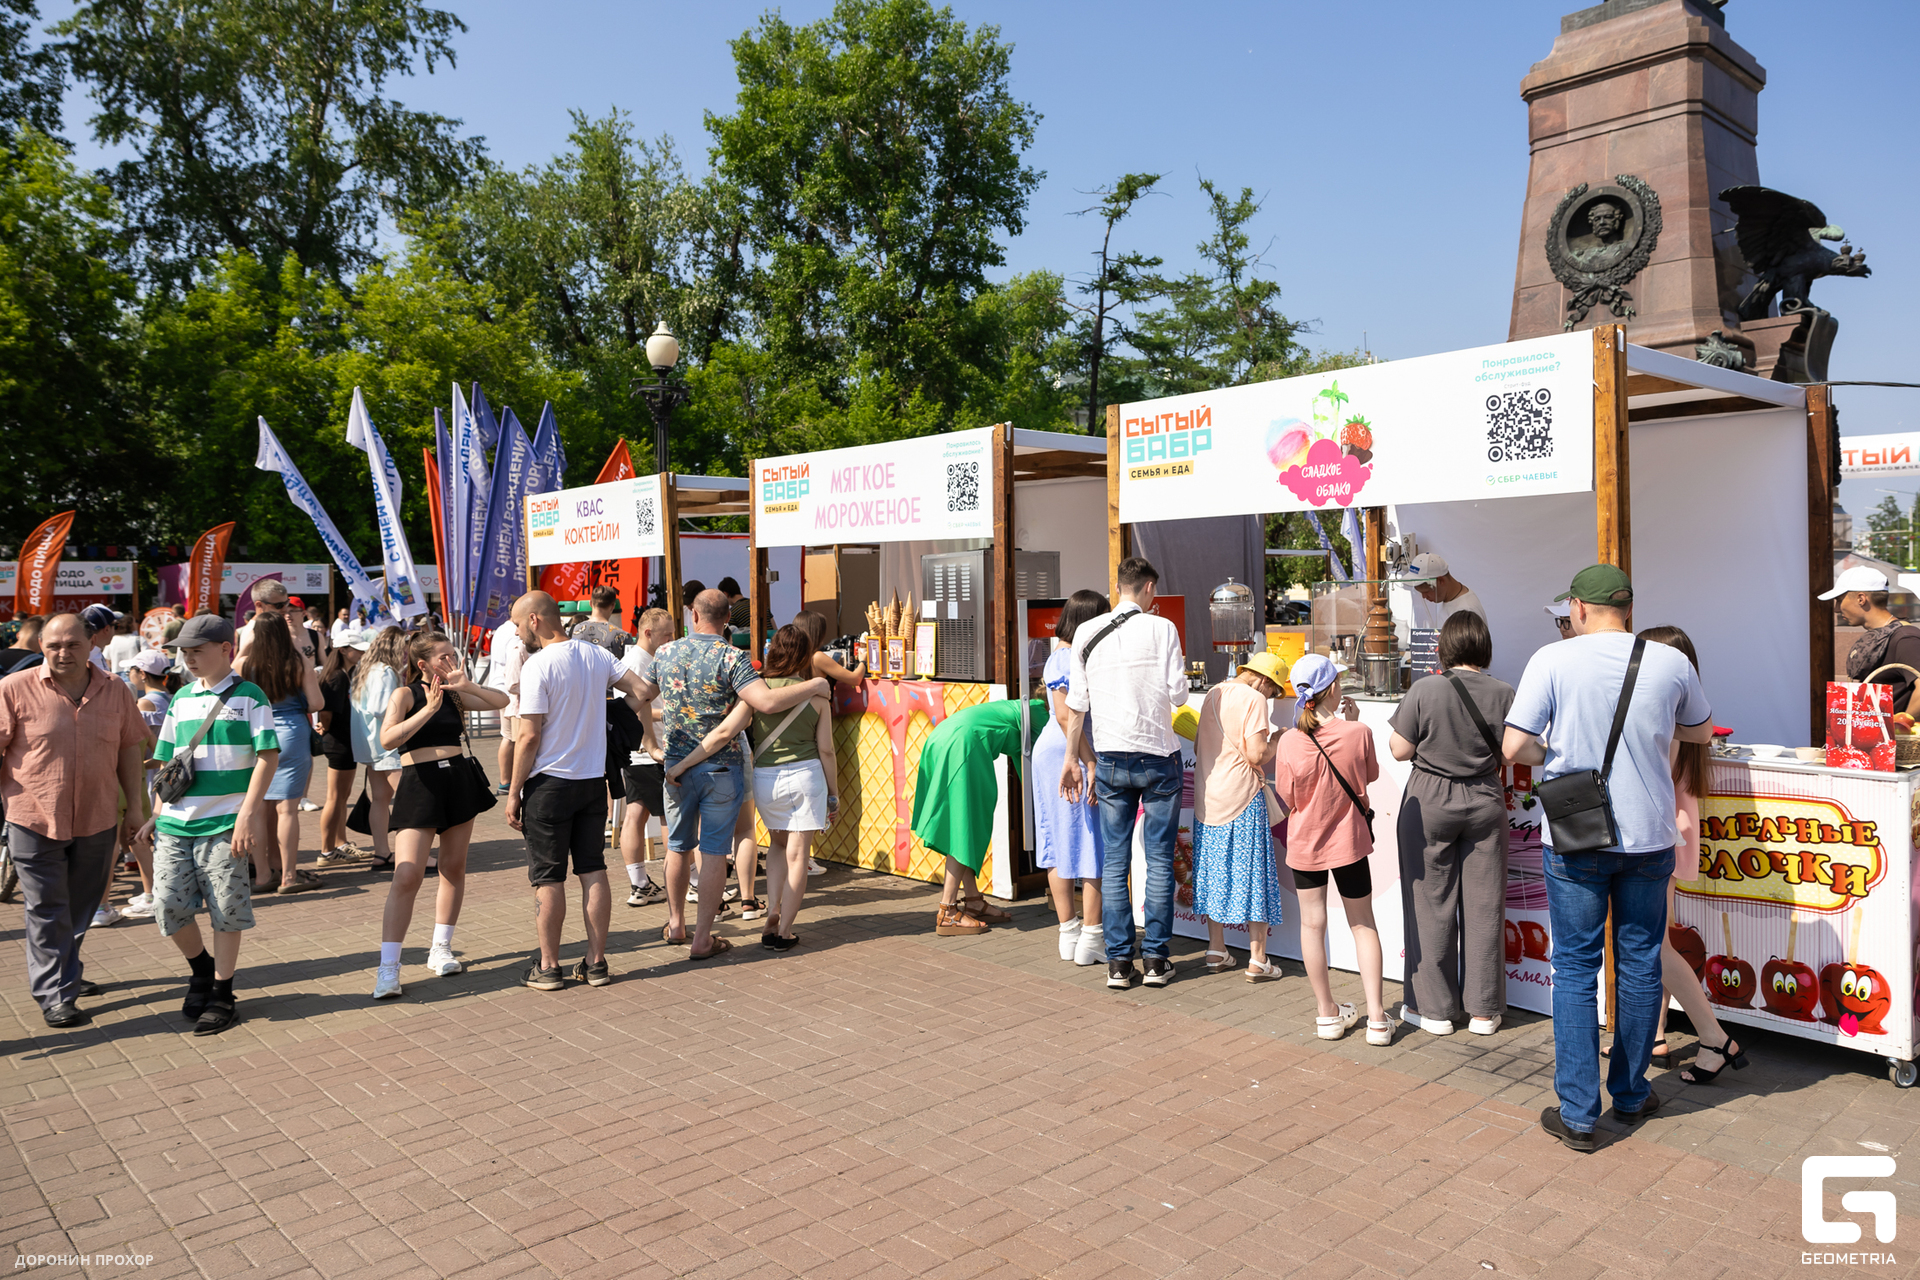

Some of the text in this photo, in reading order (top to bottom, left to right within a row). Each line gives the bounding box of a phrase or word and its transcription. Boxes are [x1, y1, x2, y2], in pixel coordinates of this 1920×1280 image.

[1482, 351, 1555, 368] Понравилось
[1475, 361, 1561, 382] обслуживание?
[1126, 404, 1211, 437] СЫТЫЙ
[1127, 428, 1212, 463] БАБР
[1842, 443, 1911, 466] ТЫЙ
[763, 461, 810, 482] СЫТЫЙ
[830, 462, 896, 493] МЯГКОЕ
[1131, 468, 1161, 479] СЕМЬЯ
[1172, 465, 1190, 475] ЕДА
[1301, 462, 1342, 478] СЛАДКОЕ
[1497, 471, 1558, 483] СБЕР ЧАЕВЫЕ
[1845, 464, 1920, 473] ГАСТРОНОМИЧЕ
[763, 479, 810, 501] БАБР
[1316, 481, 1351, 497] ОБЛАКО
[531, 497, 559, 513] СЫТЫЙ
[576, 498, 604, 518] КВАС
[814, 497, 921, 530] МОРОЖЕНОЕ
[531, 510, 560, 528] БАБР
[564, 521, 620, 545] КОКТЕЙЛИ
[29, 525, 56, 608] ДОДО ПИЦЦА
[198, 534, 217, 608] ДОДО ПИЦЦА
[1700, 812, 1880, 847] АМЕЛЬНЫЕ
[1699, 845, 1870, 897] БЛОЧКИ
